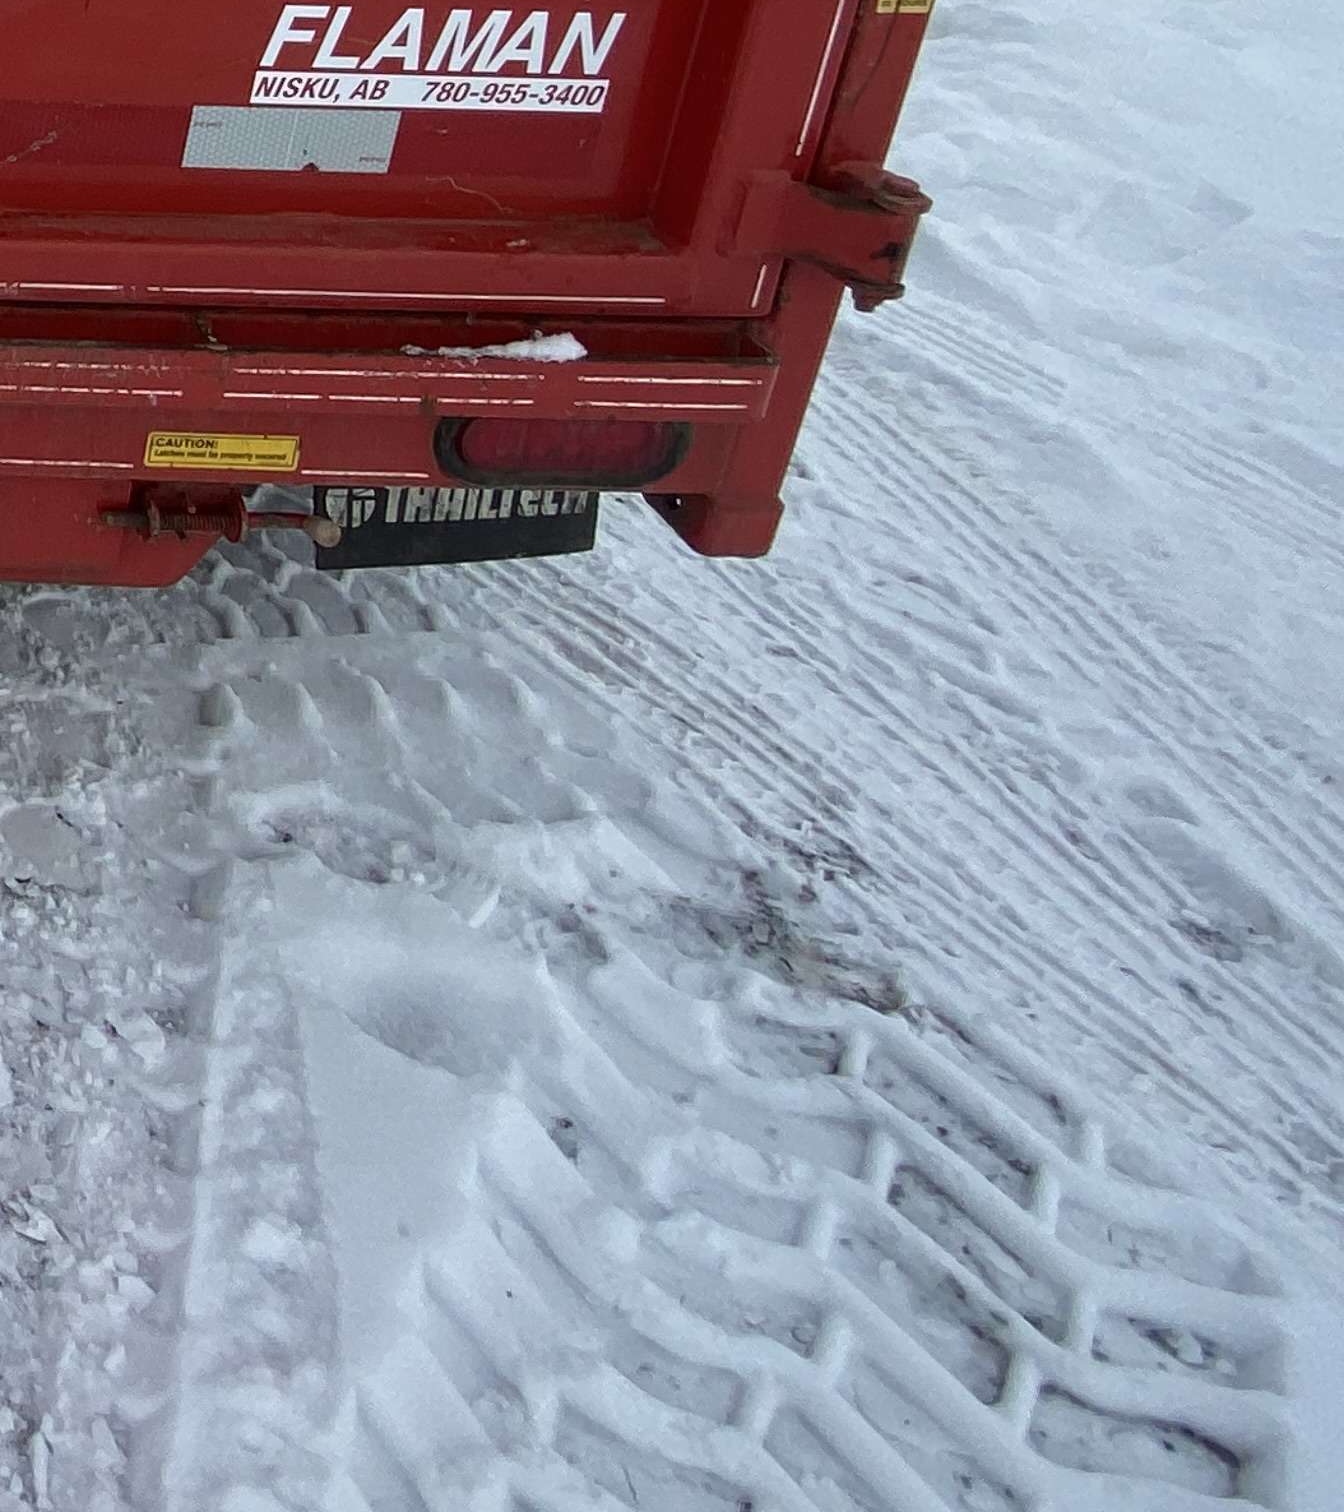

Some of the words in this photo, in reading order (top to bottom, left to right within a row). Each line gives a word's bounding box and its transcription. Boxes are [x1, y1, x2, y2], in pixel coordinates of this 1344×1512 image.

[259, 4, 627, 76] FLAMAN
[254, 77, 340, 103] NISKU,
[350, 79, 390, 101] AB
[421, 81, 605, 106] 780-955-3400
[155, 438, 218, 449] CAUTION:
